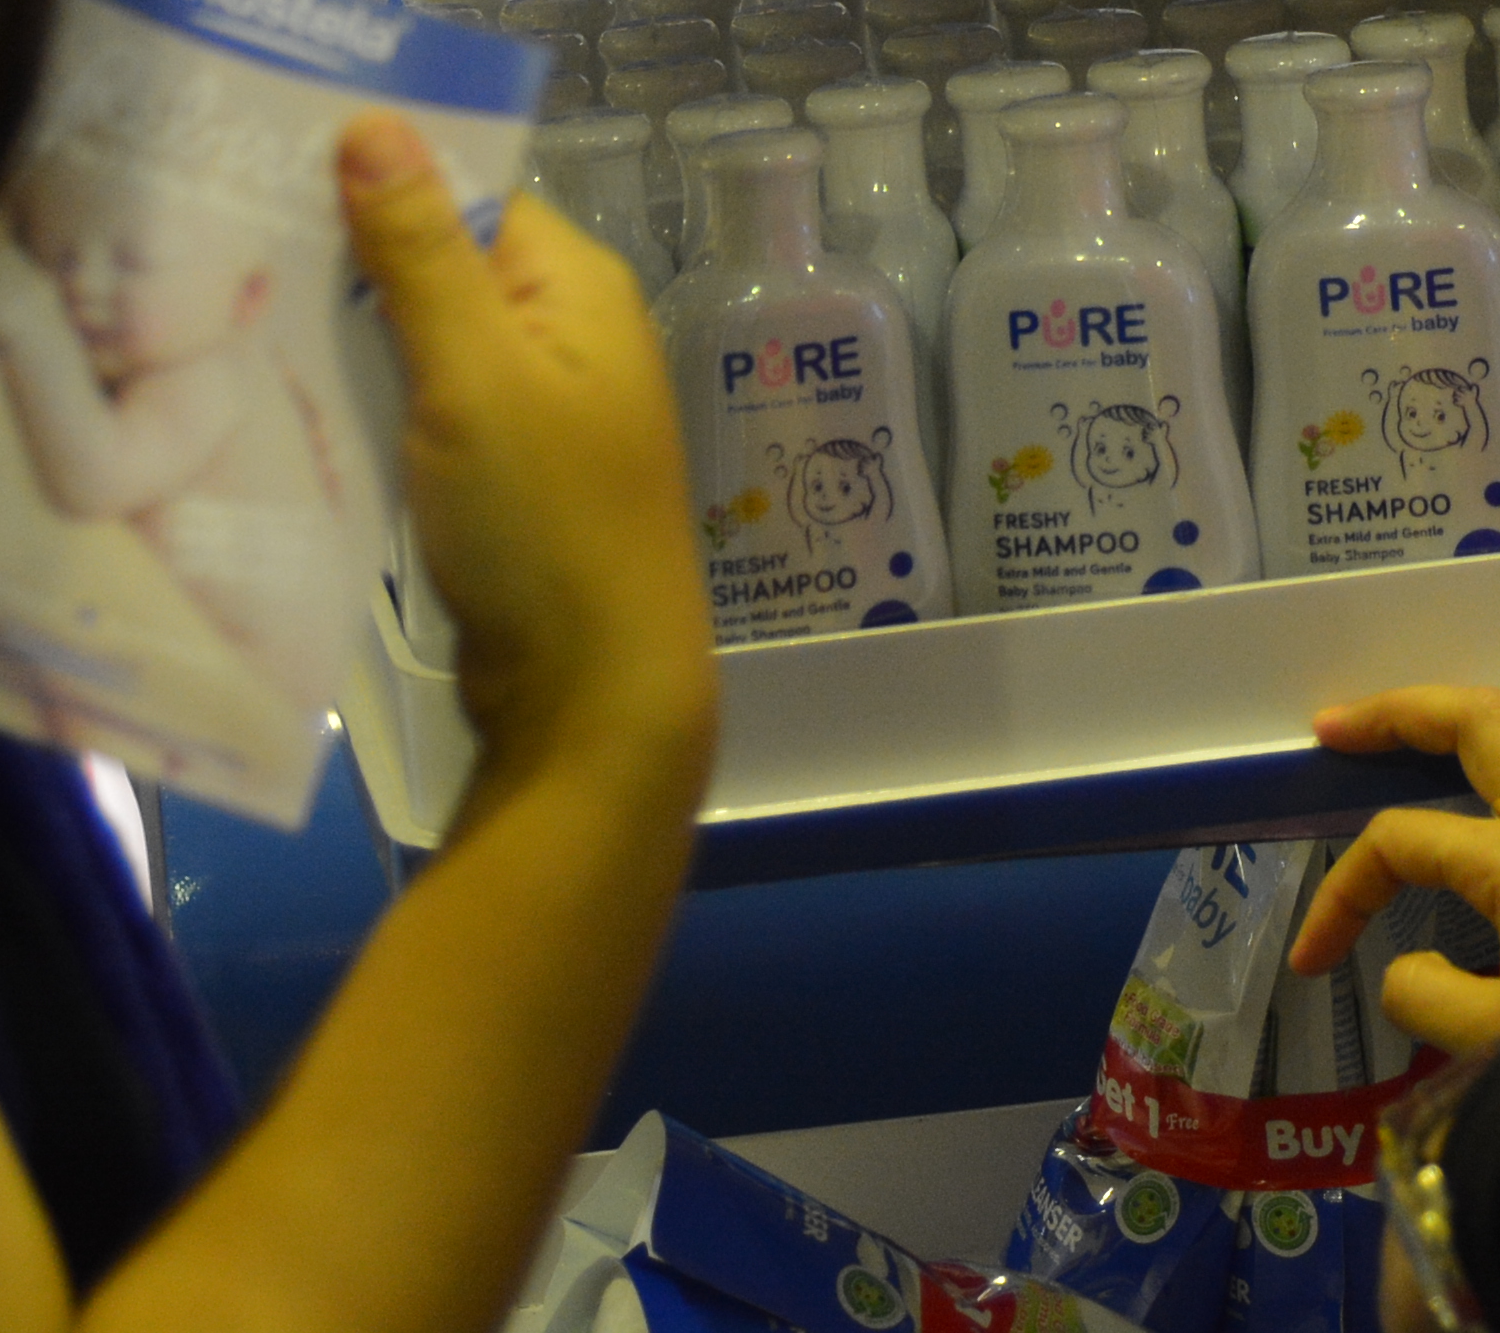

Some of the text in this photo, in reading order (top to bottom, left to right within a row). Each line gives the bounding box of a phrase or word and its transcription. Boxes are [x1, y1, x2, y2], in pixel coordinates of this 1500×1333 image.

[1319, 265, 1458, 317] PURE
[1008, 298, 1148, 350] PURE
[1411, 314, 1459, 333] baby
[723, 336, 862, 394] PURE
[1100, 349, 1149, 369] baby
[815, 384, 864, 403] baby
[1304, 476, 1382, 496] FRESHY
[994, 511, 1070, 529] FRESHY
[1307, 493, 1451, 525] SHAMPOO
[996, 530, 1139, 559] SHAMPOO
[1308, 525, 1444, 545] Extra Mild and Gentle
[709, 553, 788, 578] FRESHY
[1310, 547, 1404, 565] Baby Shampoo
[997, 562, 1132, 579] Extra Mild and Gentle
[712, 566, 857, 607] SHAMPOO
[998, 583, 1093, 598] Baby Shampoo
[751, 609, 777, 621] Mild
[781, 606, 804, 618] and
[808, 599, 850, 615] Gentle
[1179, 863, 1237, 950] baby
[1144, 1096, 1160, 1139] 1
[1165, 1111, 1200, 1132] Free
[1265, 1119, 1365, 1166] Buy
